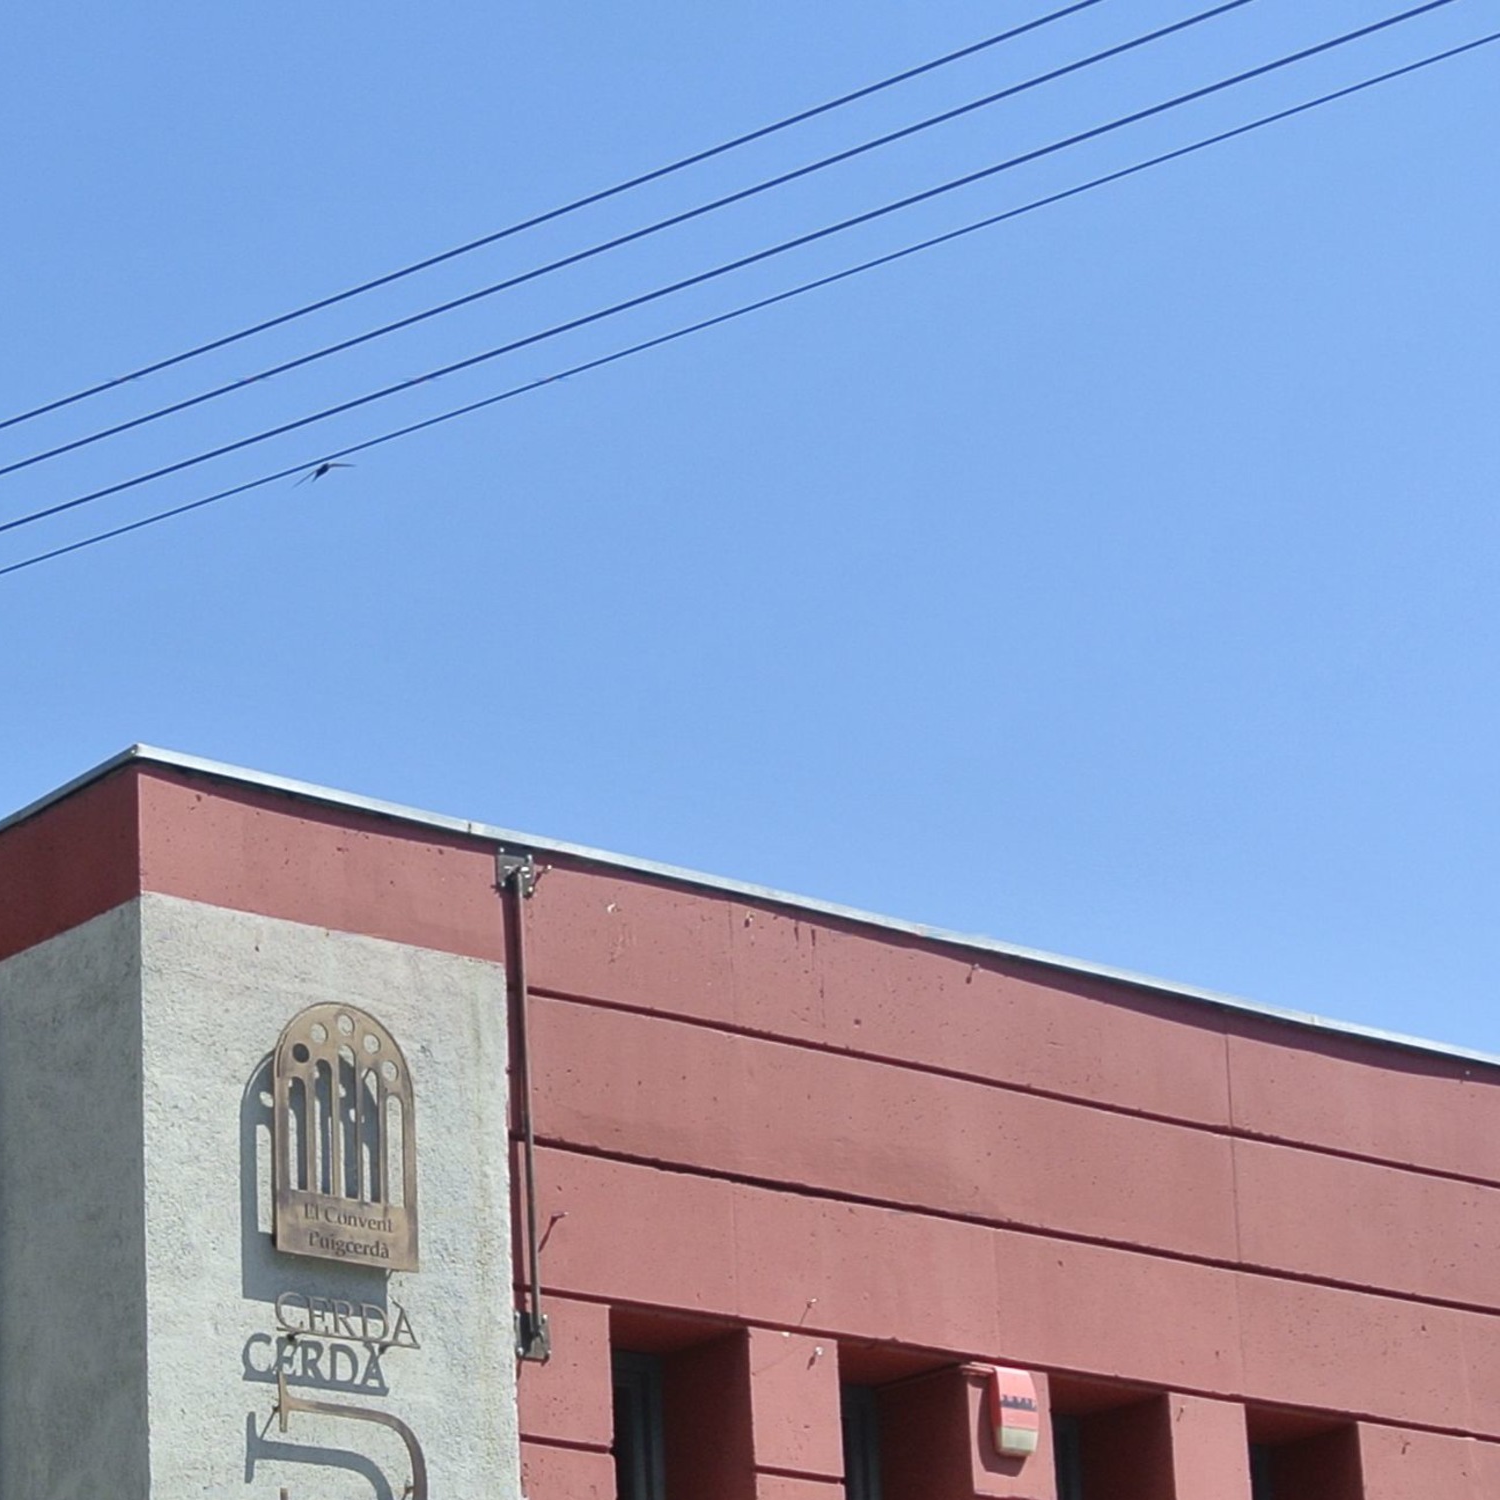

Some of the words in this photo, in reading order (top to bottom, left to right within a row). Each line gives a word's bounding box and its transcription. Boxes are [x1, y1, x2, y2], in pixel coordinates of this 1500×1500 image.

[304, 1202, 321, 1221] El
[324, 1206, 394, 1234] Convent
[309, 1230, 391, 1260] Puigcerdà
[275, 1291, 421, 1350] CERDÀ
